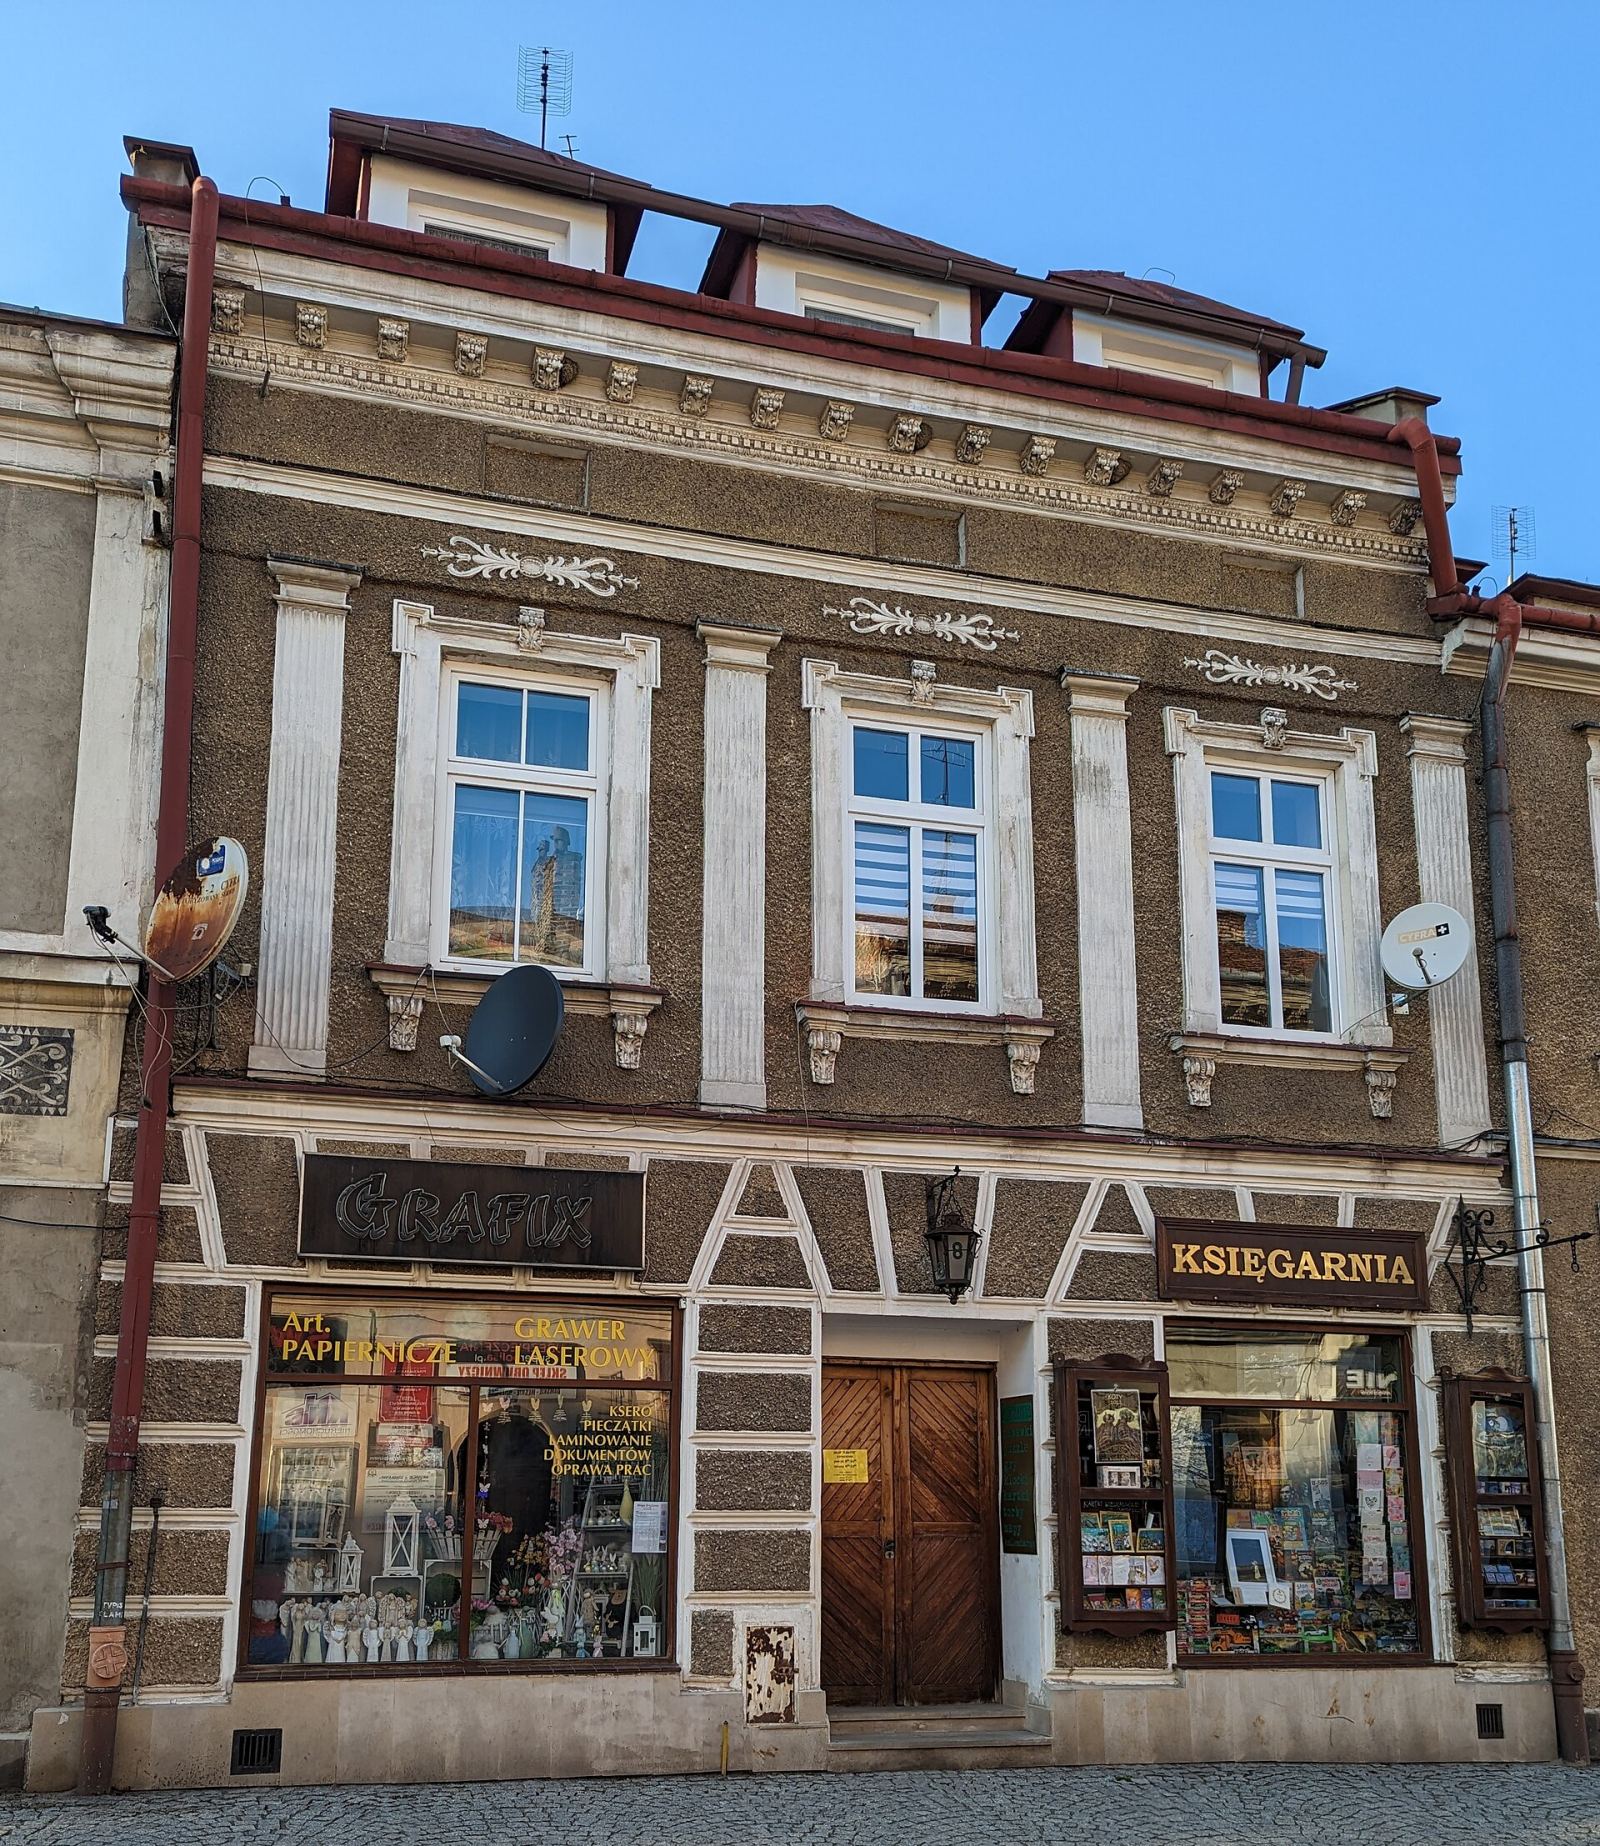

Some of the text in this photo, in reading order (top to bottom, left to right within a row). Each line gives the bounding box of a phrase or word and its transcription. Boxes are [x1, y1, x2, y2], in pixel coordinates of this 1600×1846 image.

[336, 1172, 592, 1249] GRAFIX
[952, 1241, 963, 1259] 8
[1172, 1244, 1415, 1284] KSIĘGARNIA
[282, 1311, 331, 1333] Art.
[515, 1318, 626, 1340] GRAWER
[282, 1339, 457, 1363] PAPIERNICZE
[515, 1345, 655, 1368] LASEROWY
[609, 1405, 652, 1417] KSERO
[583, 1420, 652, 1434] PIECZĄTKI
[549, 1434, 652, 1447] LAMINOWANIE
[543, 1446, 652, 1461] DOKUMENTÓW
[551, 1463, 652, 1476] OPRAWA PRAC
